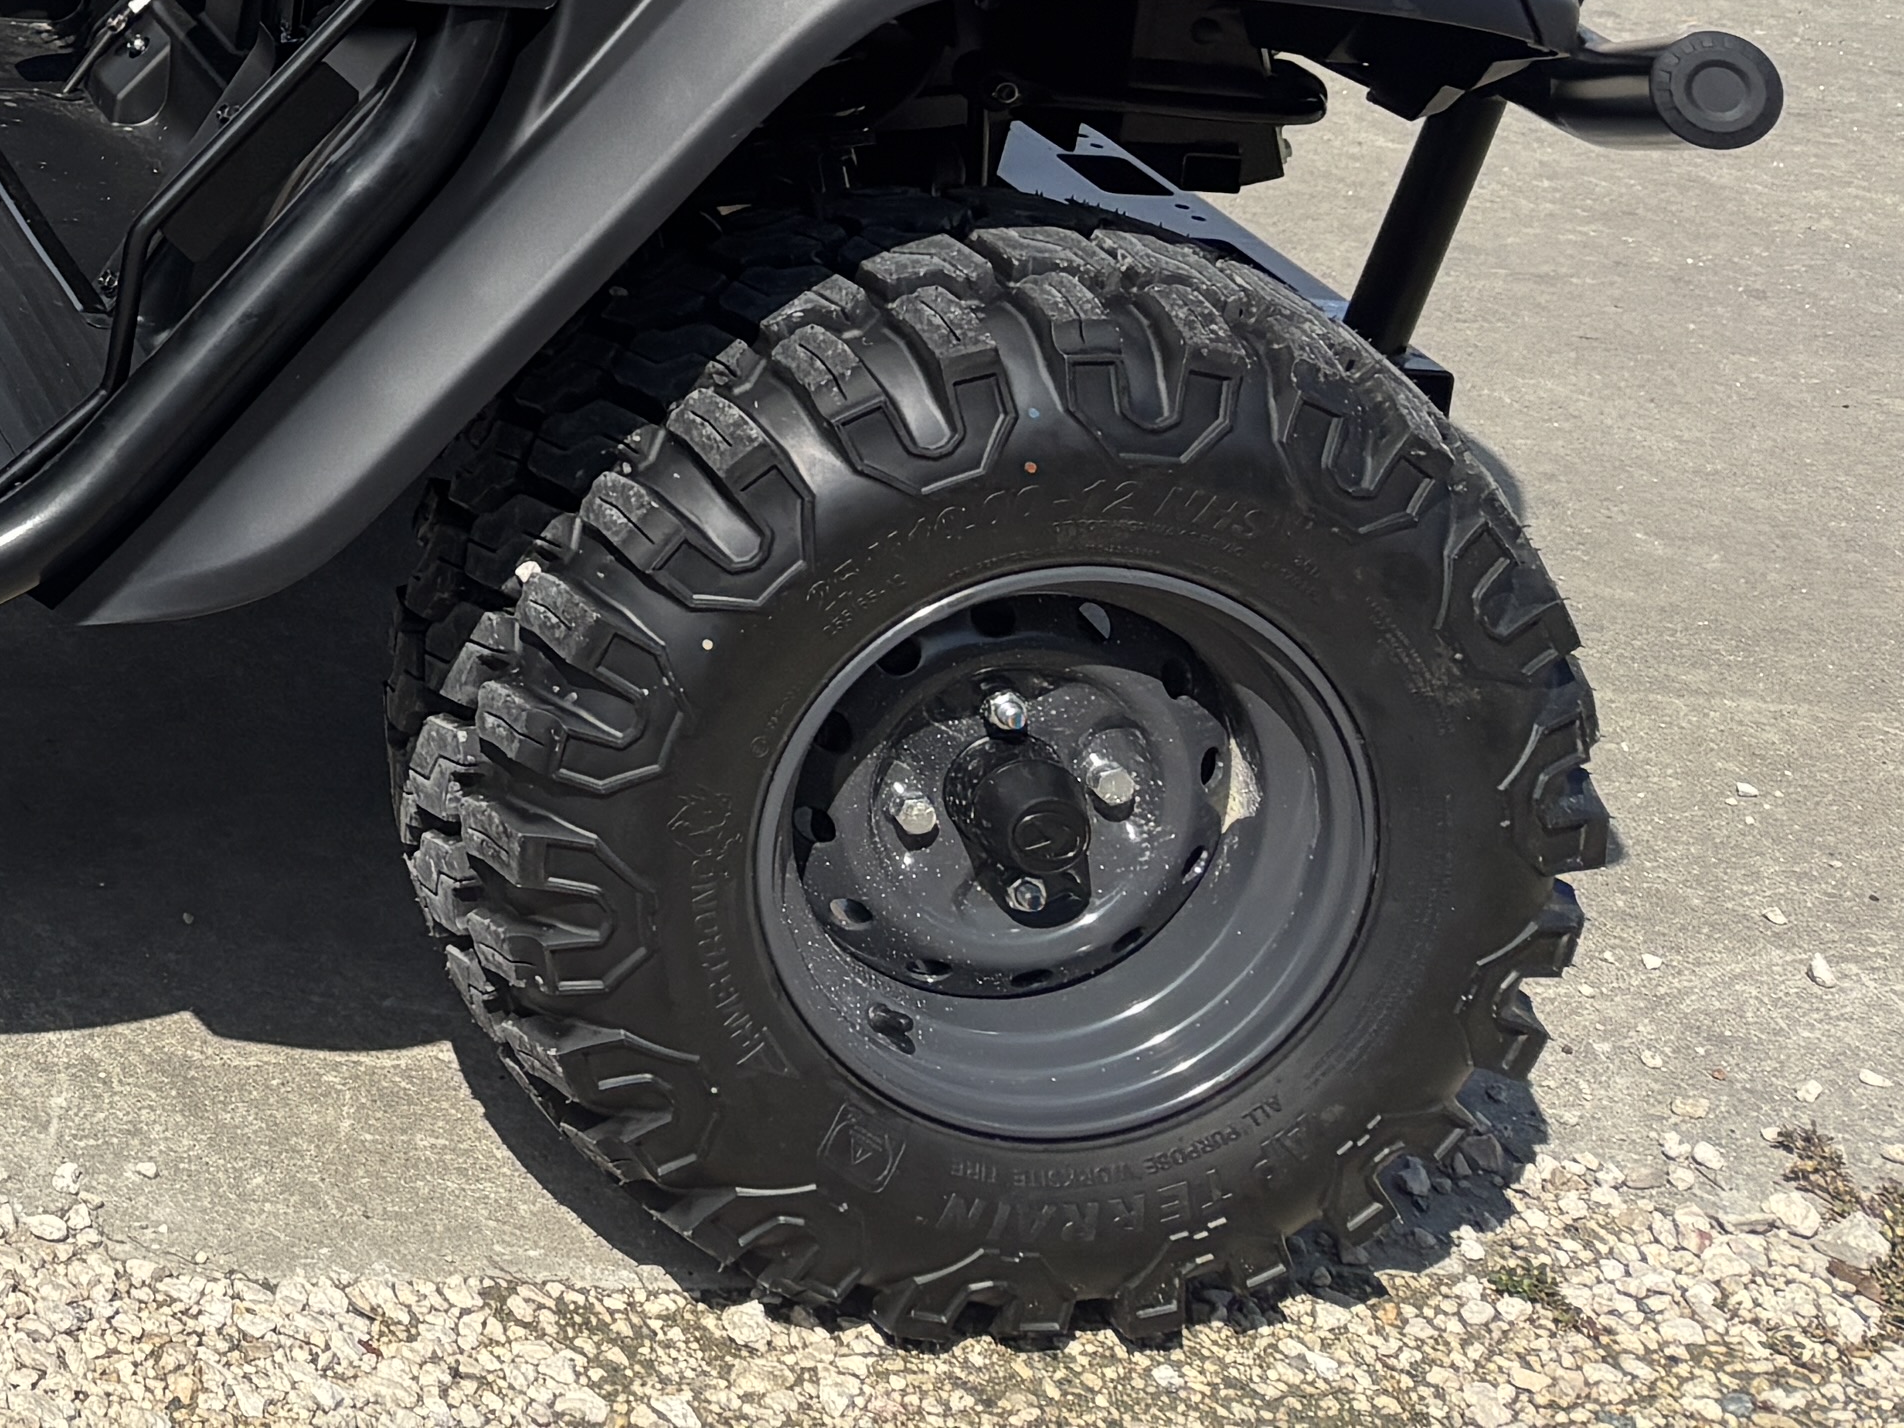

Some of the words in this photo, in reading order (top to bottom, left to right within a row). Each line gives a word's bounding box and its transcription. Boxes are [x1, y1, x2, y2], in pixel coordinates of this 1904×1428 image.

[1241, 1092, 1283, 1128] ALL
[1142, 1126, 1240, 1177] PURPOSE
[936, 1166, 1235, 1242] TERRAIN
